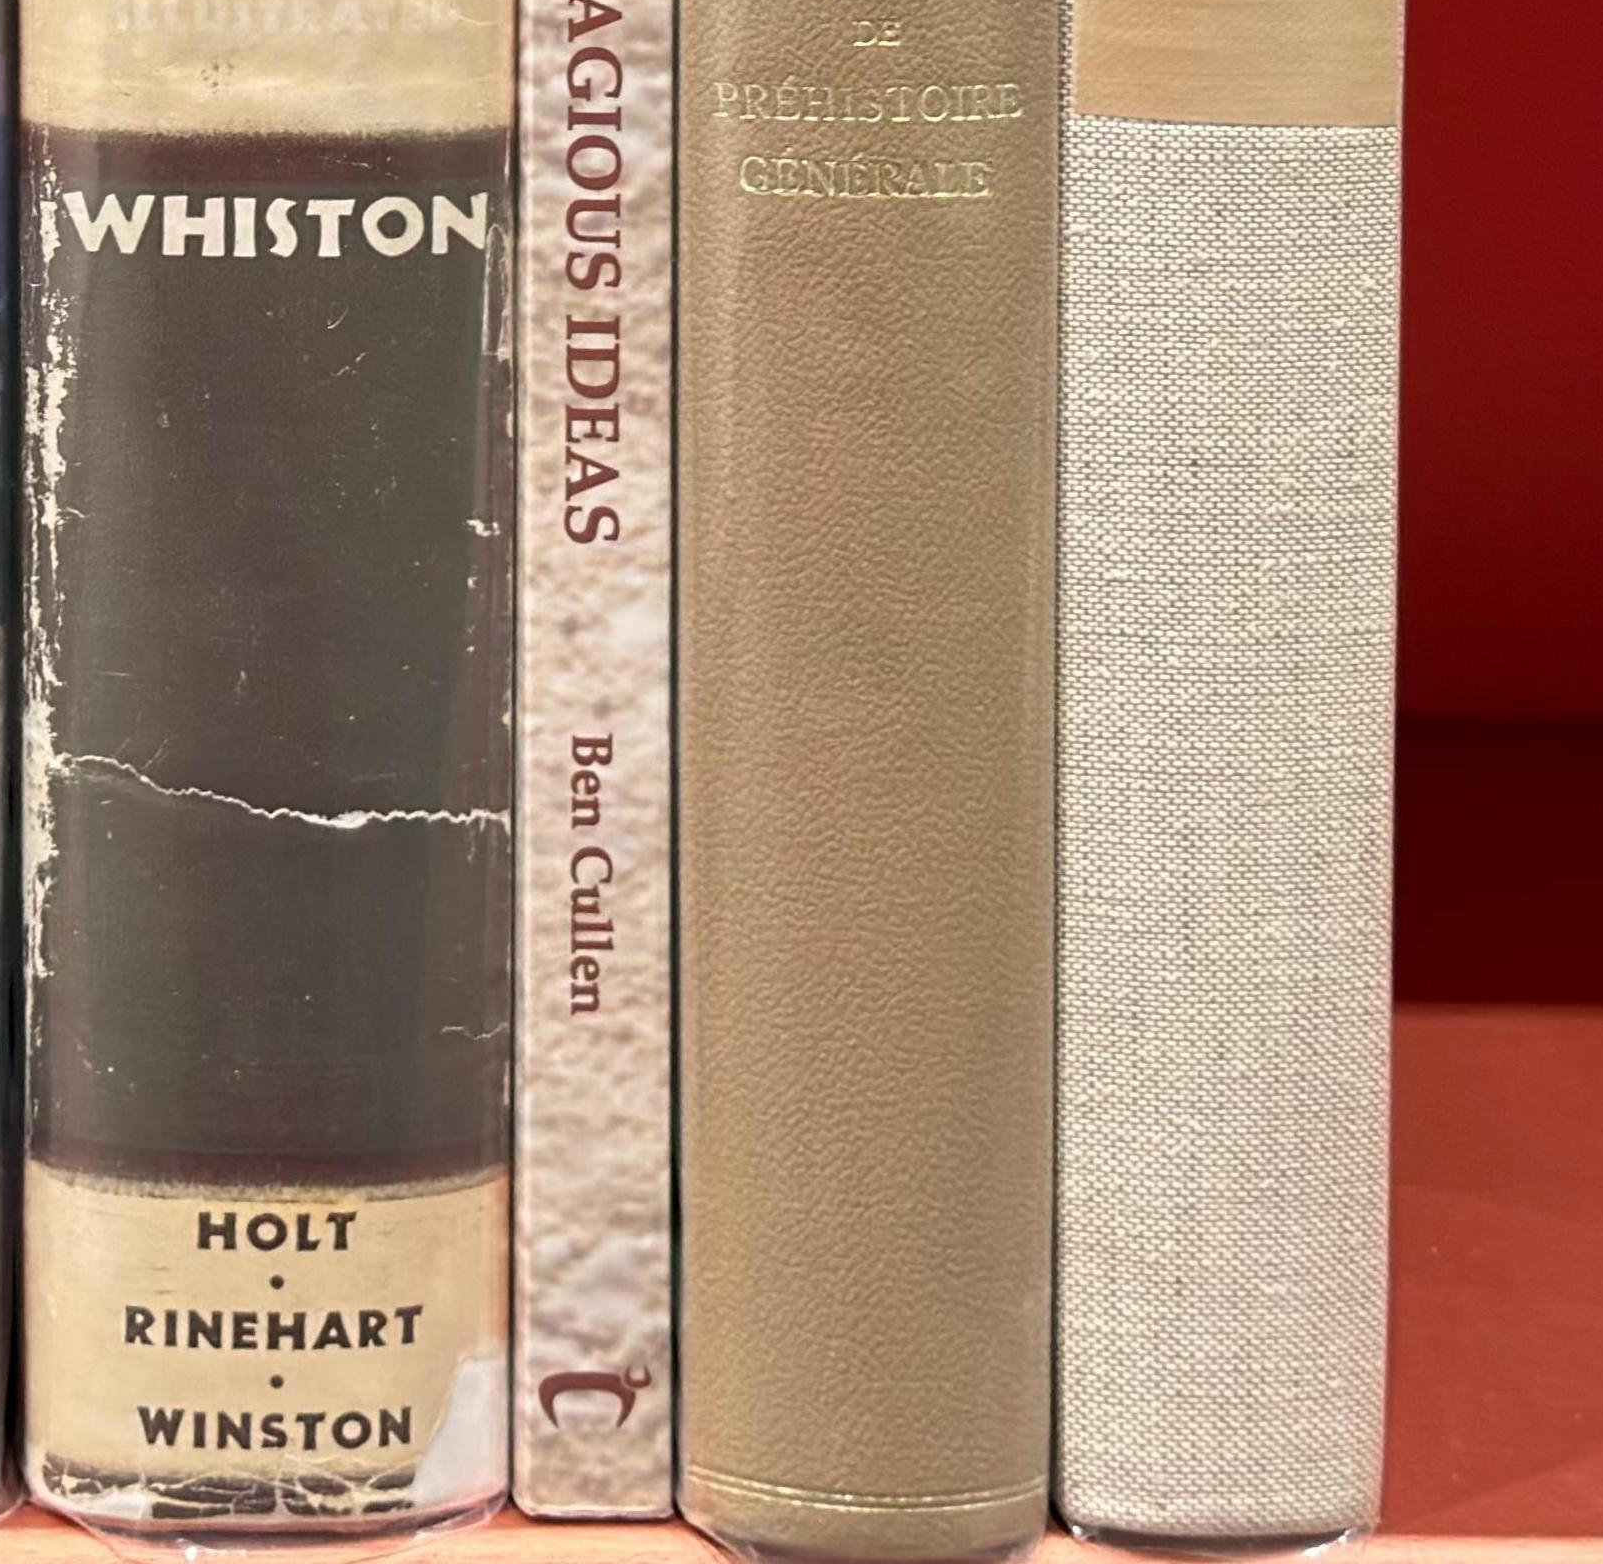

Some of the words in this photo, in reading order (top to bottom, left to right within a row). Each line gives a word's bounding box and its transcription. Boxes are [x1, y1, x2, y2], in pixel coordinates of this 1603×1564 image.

[852, 20, 901, 47] DE
[712, 75, 1023, 123] PRÉHISTOIRE
[739, 146, 995, 198] GÉNÉRALE
[63, 191, 488, 258] WHISTON
[563, 314, 621, 546] IDEAS
[569, 731, 615, 830] Ben
[569, 846, 616, 1016] Cullen
[197, 1211, 358, 1251] HOLT
[124, 1305, 425, 1350] RINEHART
[137, 1405, 413, 1451] WINSTON
